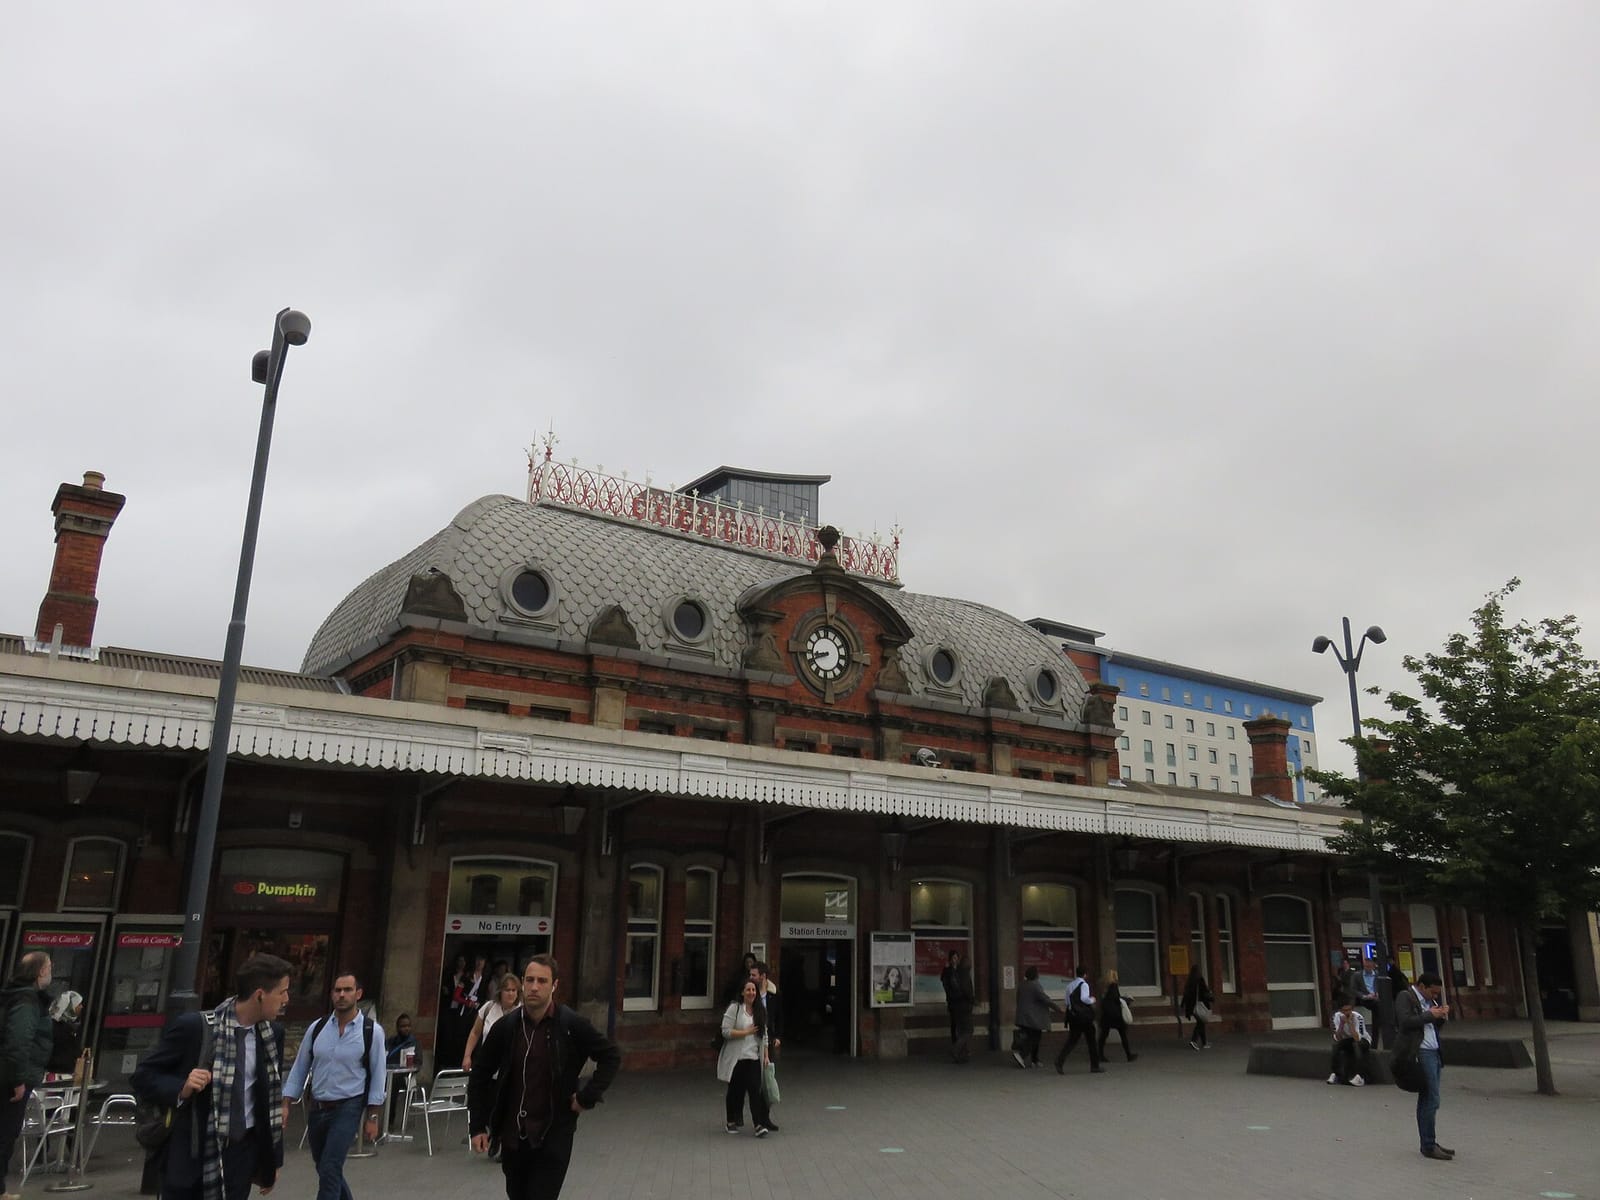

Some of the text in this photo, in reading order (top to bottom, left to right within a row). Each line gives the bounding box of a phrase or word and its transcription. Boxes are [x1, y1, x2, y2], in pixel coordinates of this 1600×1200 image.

[257, 882, 317, 896] Pumpkin
[478, 921, 521, 933] No Entry
[788, 928, 848, 936] Station Entrance
